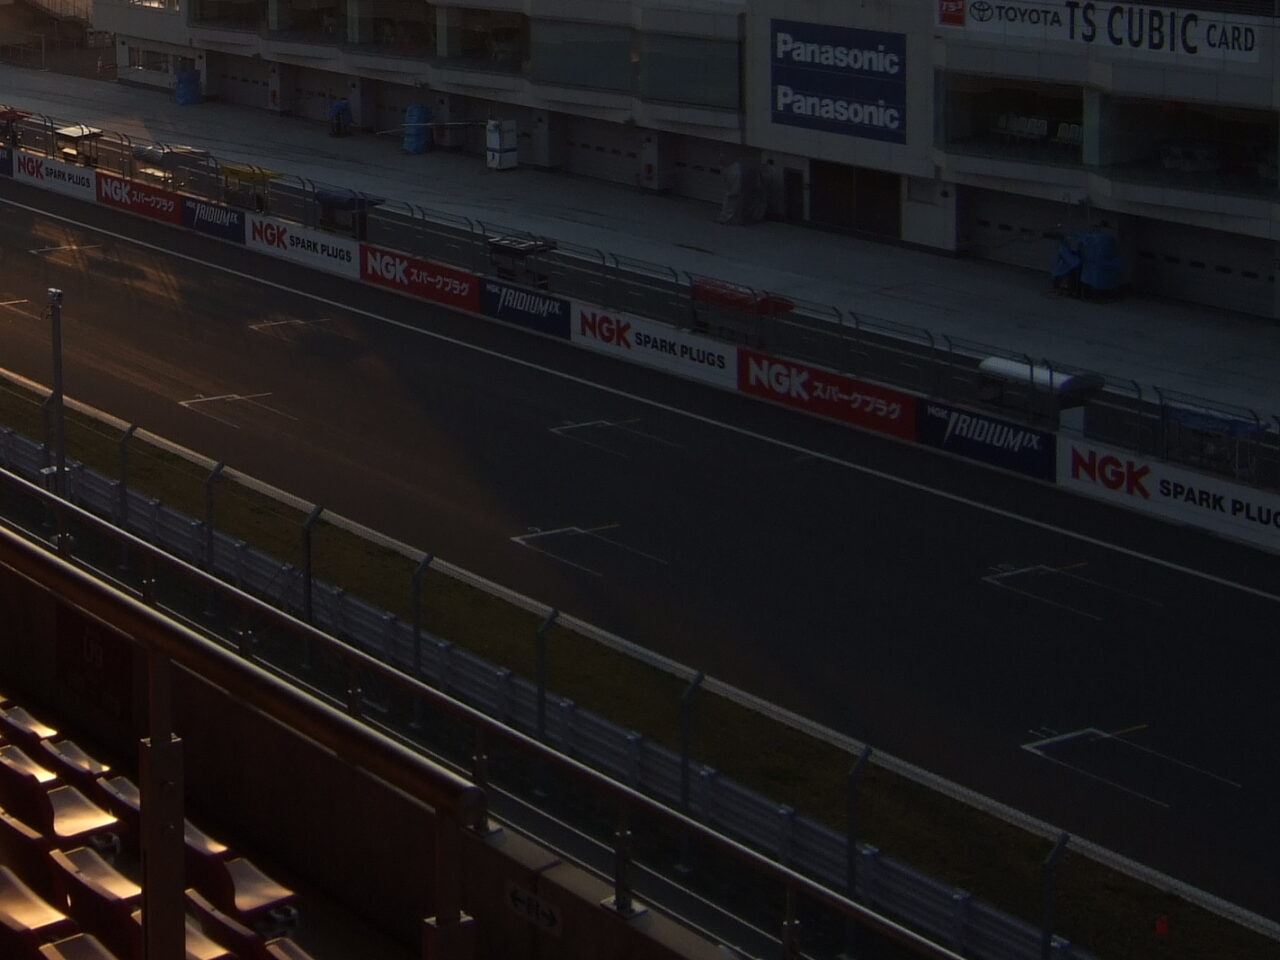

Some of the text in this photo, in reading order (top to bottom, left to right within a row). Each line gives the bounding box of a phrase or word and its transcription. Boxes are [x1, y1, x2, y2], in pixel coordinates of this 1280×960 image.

[995, 1, 1255, 54] TOYOTA TS CUBIC CARD
[776, 33, 899, 75] Panasonic
[776, 85, 899, 129] Panasonic
[17, 155, 91, 188] NGK SPARK PLUGS
[101, 178, 175, 214] NGK スパークプラグ
[194, 202, 230, 228] IRIDIUM
[251, 220, 352, 263] NGK SPARK PLUGS
[367, 250, 470, 297] NGK スパークプラグ
[497, 286, 547, 316] IRIDIUM
[581, 312, 726, 370] NGK SPARK PLUGS
[748, 356, 901, 421] NGK スパークプラグ
[927, 405, 948, 420] NGK
[943, 412, 1023, 452] IRIDIUM
[1072, 446, 1152, 500] NGK
[1159, 479, 1227, 513] SPARK
